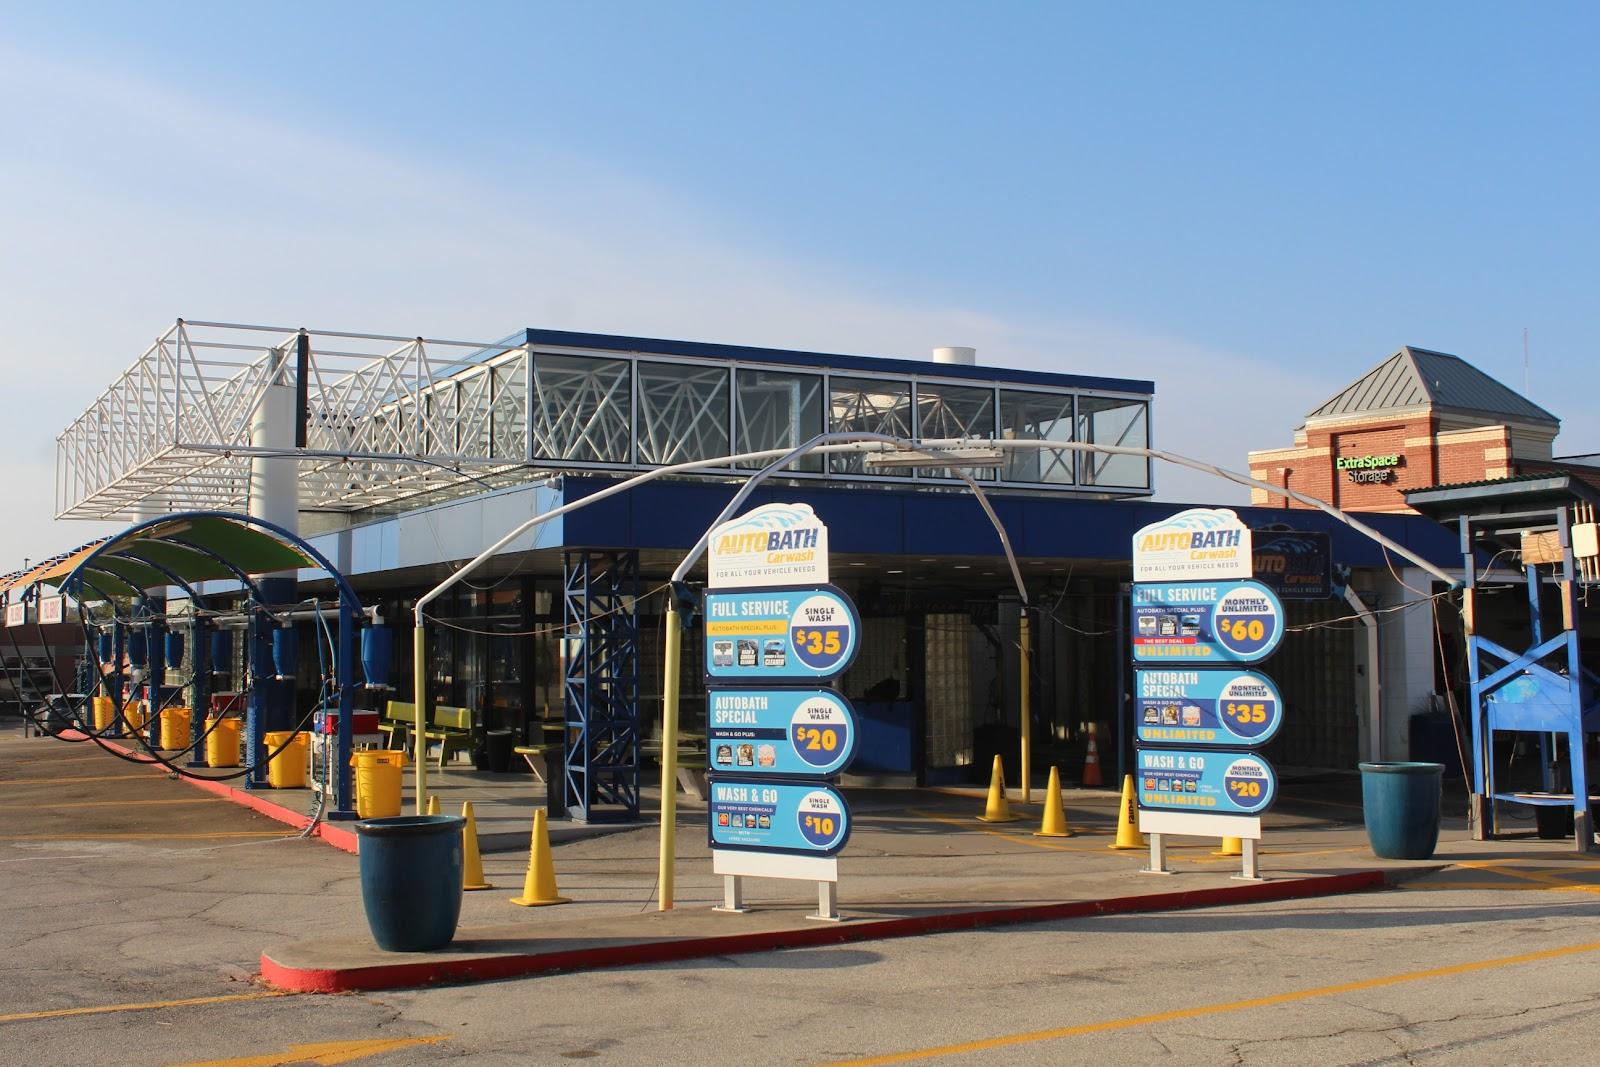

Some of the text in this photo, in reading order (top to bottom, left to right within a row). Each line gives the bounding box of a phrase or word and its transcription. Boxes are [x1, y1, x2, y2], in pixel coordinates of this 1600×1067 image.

[1348, 470, 1388, 482] Storage
[717, 528, 818, 555] AUTOBATH
[1140, 529, 1240, 552] AUTOBATH
[767, 550, 814, 564] Carwash
[1190, 550, 1236, 560] Carwash
[716, 570, 728, 578] FOR
[730, 569, 742, 577] ALL
[744, 568, 762, 576] YOUR
[764, 566, 792, 575] VEHICLE
[1136, 587, 1216, 602] FULL SERVICE
[712, 600, 790, 617] FULL SERVICE
[805, 607, 835, 615] SINGLE
[808, 614, 832, 622] WASH
[1220, 618, 1264, 641] $60
[796, 628, 841, 655] $35
[1138, 646, 1212, 656] UNLIMITED
[1143, 672, 1198, 685] AUTOBATH
[1143, 685, 1187, 697] SPECIAL
[716, 696, 768, 710] AUTOBATH
[716, 710, 758, 724] SPECIAL
[1227, 703, 1266, 724] $35
[797, 727, 837, 751] $20
[1143, 729, 1216, 740] UNLIMITED
[1144, 755, 1204, 770] WASH & GO
[717, 787, 778, 803] WASH & GO
[1231, 781, 1260, 797] $20
[1144, 793, 1216, 806] UNLIMITED
[805, 816, 833, 835] $10
